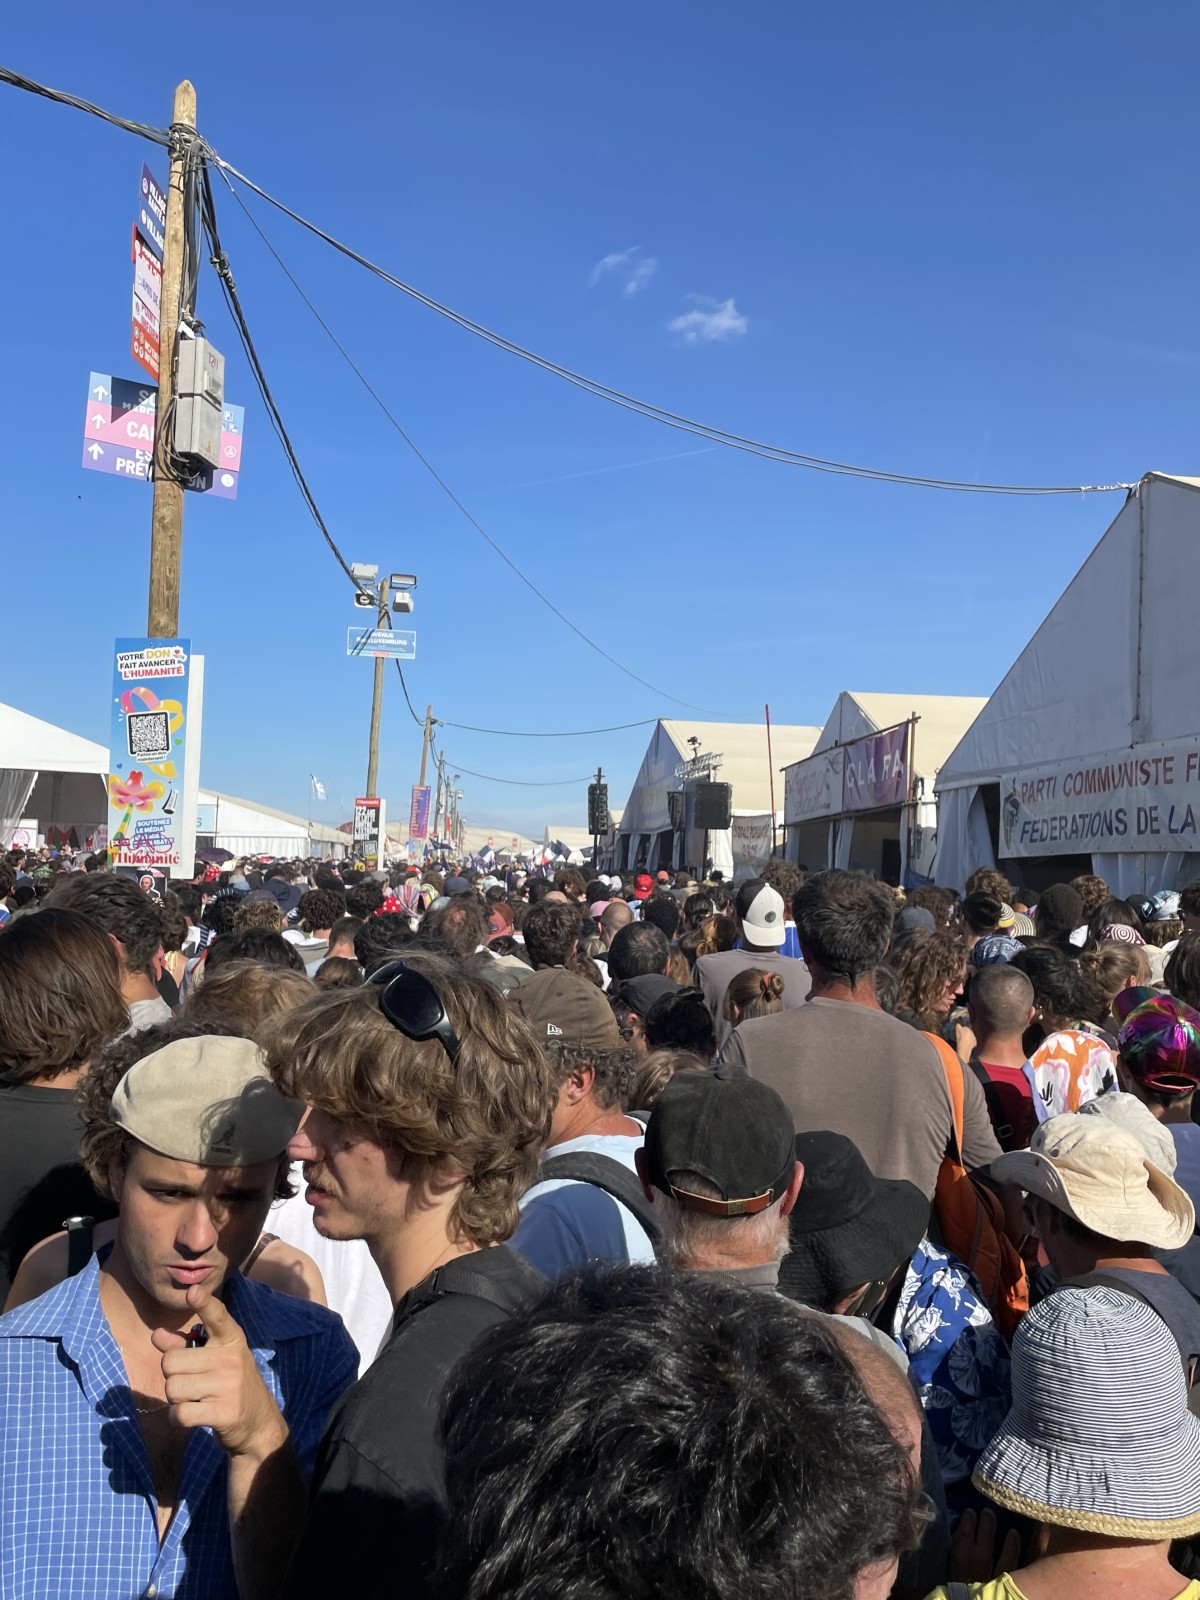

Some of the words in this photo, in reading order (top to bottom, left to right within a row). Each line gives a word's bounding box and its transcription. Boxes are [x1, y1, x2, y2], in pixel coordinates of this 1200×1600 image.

[119, 652, 145, 662] VOTRE
[146, 649, 170, 660] DON
[119, 662, 138, 670] FAIT
[138, 659, 176, 668] AVANCER
[123, 665, 183, 679] L'HUMANITÉ
[1021, 775, 1057, 804] PARTI
[1063, 756, 1175, 797] COMMUNISTE
[1186, 752, 1200, 783] F
[137, 819, 171, 827] SOUTENEZ
[1020, 808, 1128, 844] FEDERATIONS
[1136, 805, 1161, 836] DE
[1168, 803, 1197, 835] LA
